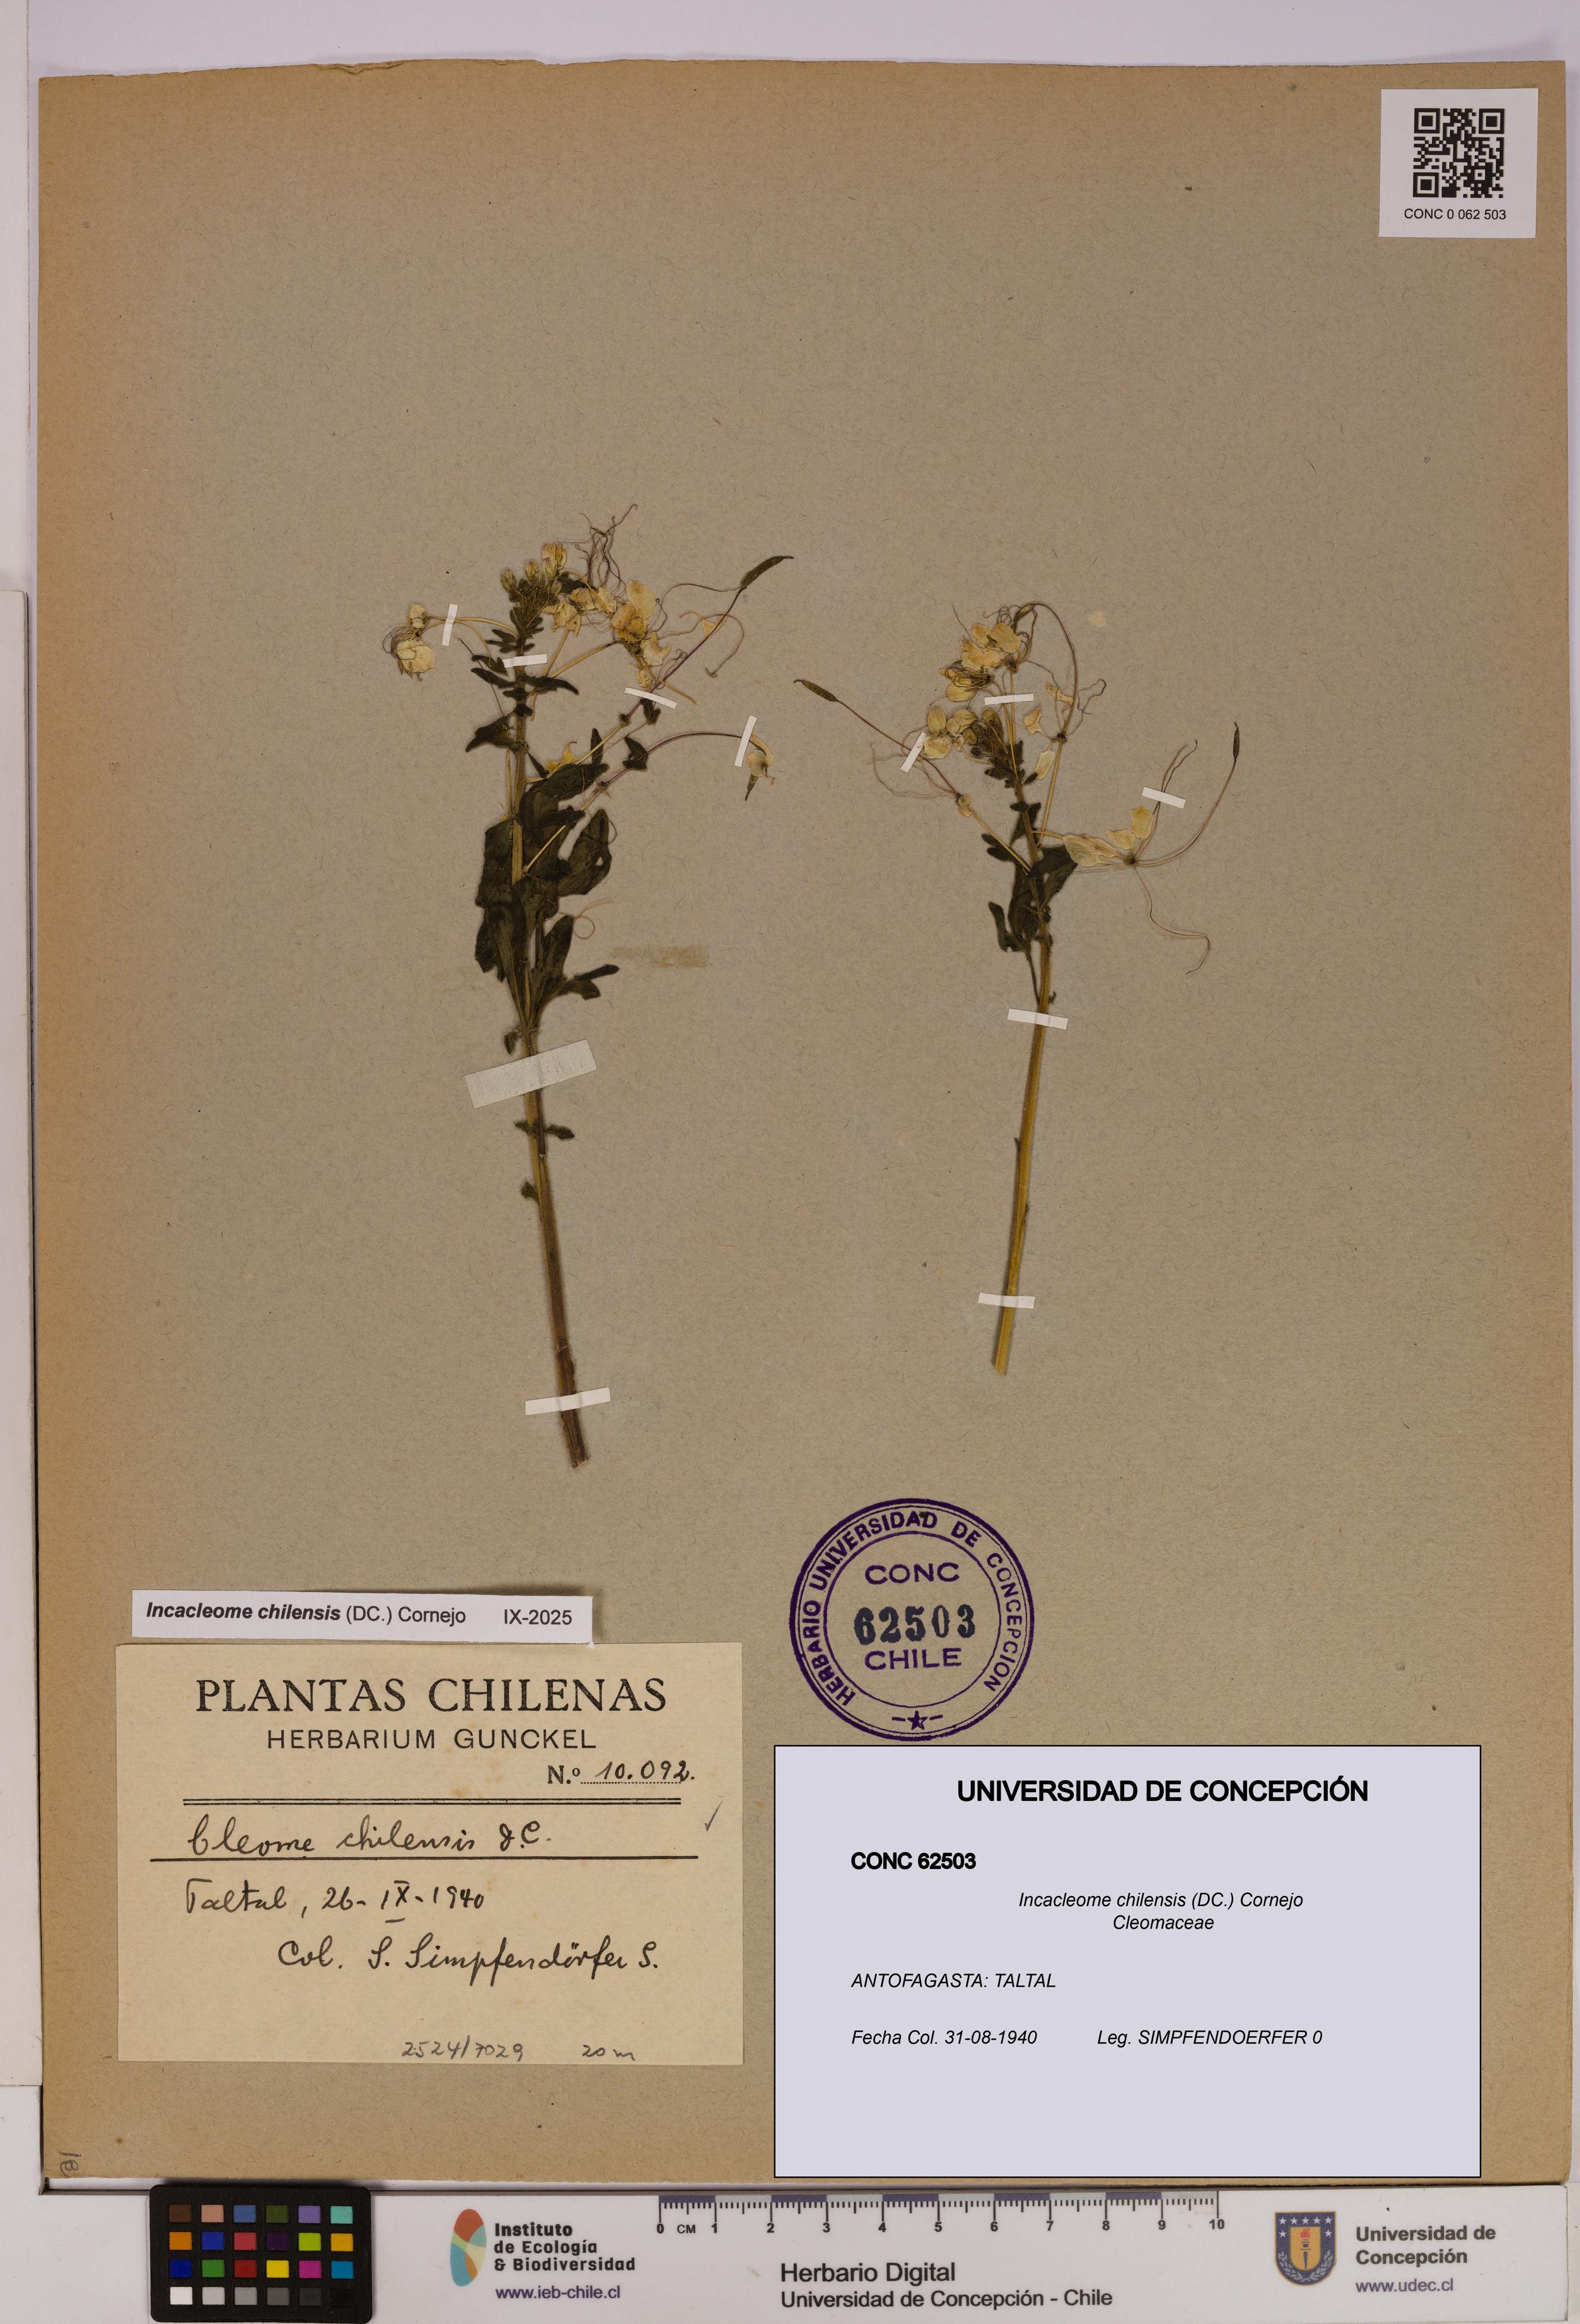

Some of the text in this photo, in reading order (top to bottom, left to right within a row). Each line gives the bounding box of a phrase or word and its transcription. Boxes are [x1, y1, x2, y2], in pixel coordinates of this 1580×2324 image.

[1405, 209, 1506, 219] CONC 0 062 503
[865, 1563, 959, 1585] CONC
[147, 1602, 572, 1627] Incacleome chilensis (DC.) Cornejo IX-2025
[803, 1512, 1023, 1706] HERBARIO UNIVERSIDAD DE CONCEPCION
[854, 1604, 975, 1645] 62503
[865, 1648, 961, 1670] CHILE
[196, 1678, 665, 1711] PLANTAS CHILENAS
[268, 1729, 596, 1749] HERBARIUM GUNCKEL
[336, 1815, 473, 1851] chilensis
[279, 1935, 341, 1968] Col.
[496, 2222, 572, 2236] Instituto
[656, 2219, 1224, 2233] 0 CM 1 2 3 4 5 6 7 8 9 10
[1357, 2225, 1496, 2241] Universidad de
[494, 2240, 596, 2256] de Ecología
[1356, 2248, 1467, 2267] Concepción
[495, 2257, 635, 2271] & Biodiversidad
[782, 2262, 955, 2286] Herbario Digital
[496, 2286, 620, 2299] www.ieb-chile.cl
[1356, 2278, 1453, 2292] www.udec.cl
[782, 2291, 893, 2308] Universidad
[900, 2291, 924, 2307] de
[931, 2290, 1043, 2310] Concepción
[1064, 2289, 1112, 2306] Chile
